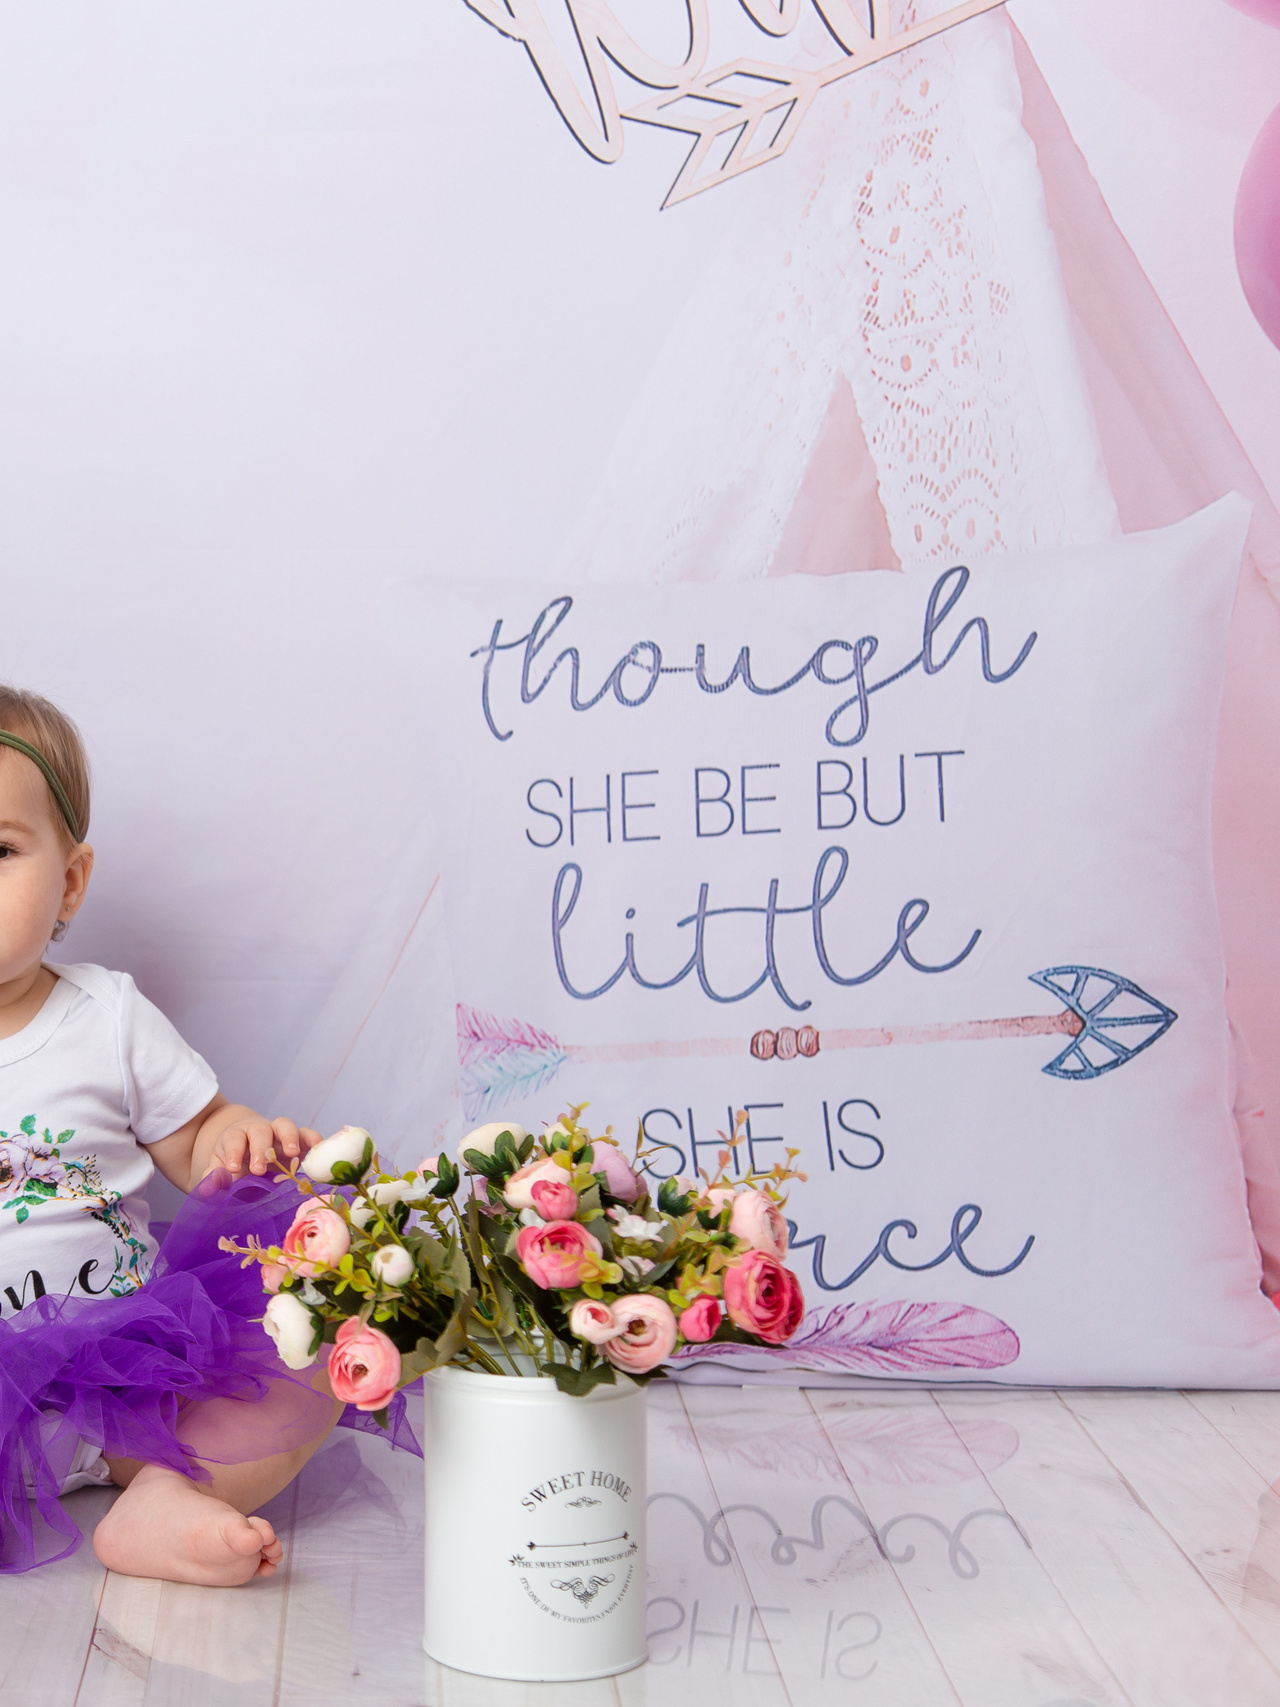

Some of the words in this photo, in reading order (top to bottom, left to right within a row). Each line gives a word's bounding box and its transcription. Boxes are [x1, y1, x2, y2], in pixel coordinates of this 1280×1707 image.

[470, 565, 1037, 746] though
[525, 770, 661, 848] SHE
[695, 763, 781, 838] BE
[816, 751, 965, 831] BUT
[552, 846, 982, 1011] little
[641, 1102, 792, 1179] SHE
[822, 1099, 885, 1171] IS
[788, 1203, 1036, 1291] rce
[521, 1471, 586, 1513] SWEET
[590, 1470, 632, 1503] HOME
[535, 1560, 562, 1569] SWEET
[564, 1559, 592, 1569] SIMPLE
[592, 1554, 617, 1566] THINGS
